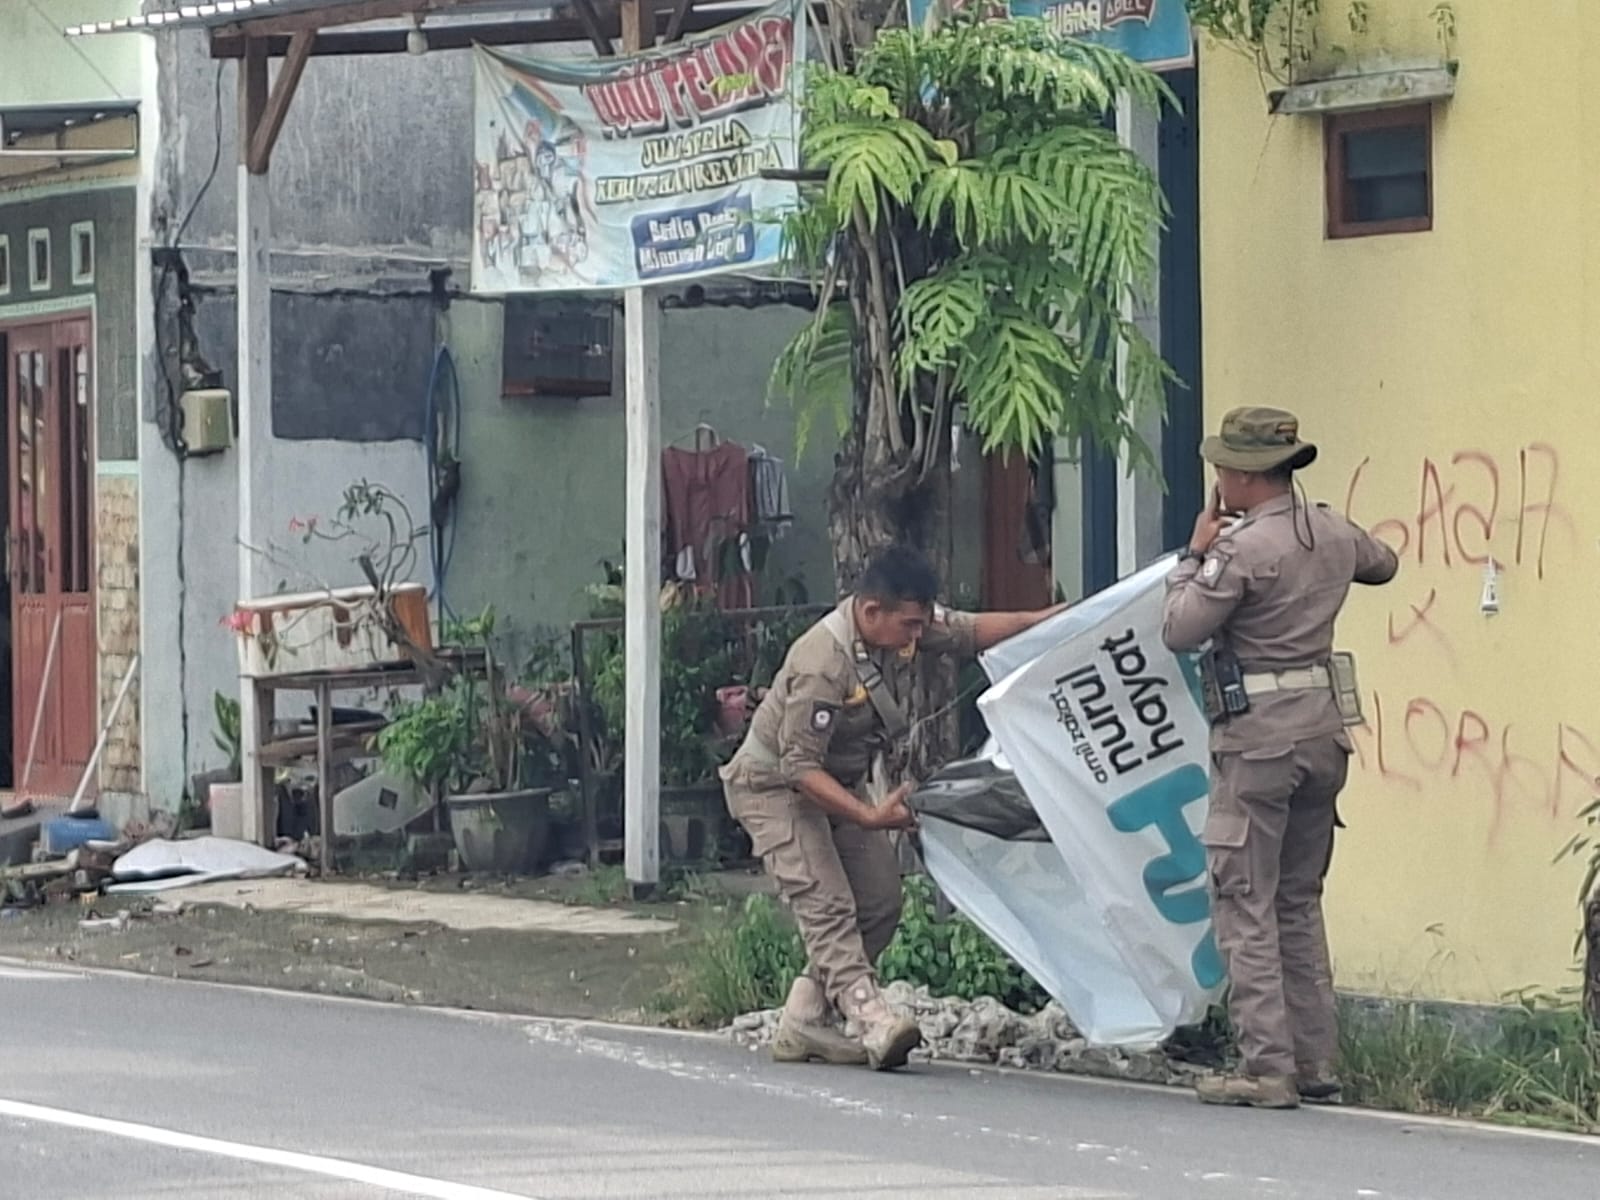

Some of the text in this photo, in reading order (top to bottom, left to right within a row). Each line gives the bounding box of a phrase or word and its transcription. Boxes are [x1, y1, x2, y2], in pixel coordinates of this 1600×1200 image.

[1048, 686, 1109, 784] amil zakat
[1055, 663, 1144, 776] nurul
[1100, 628, 1185, 762] hayat
